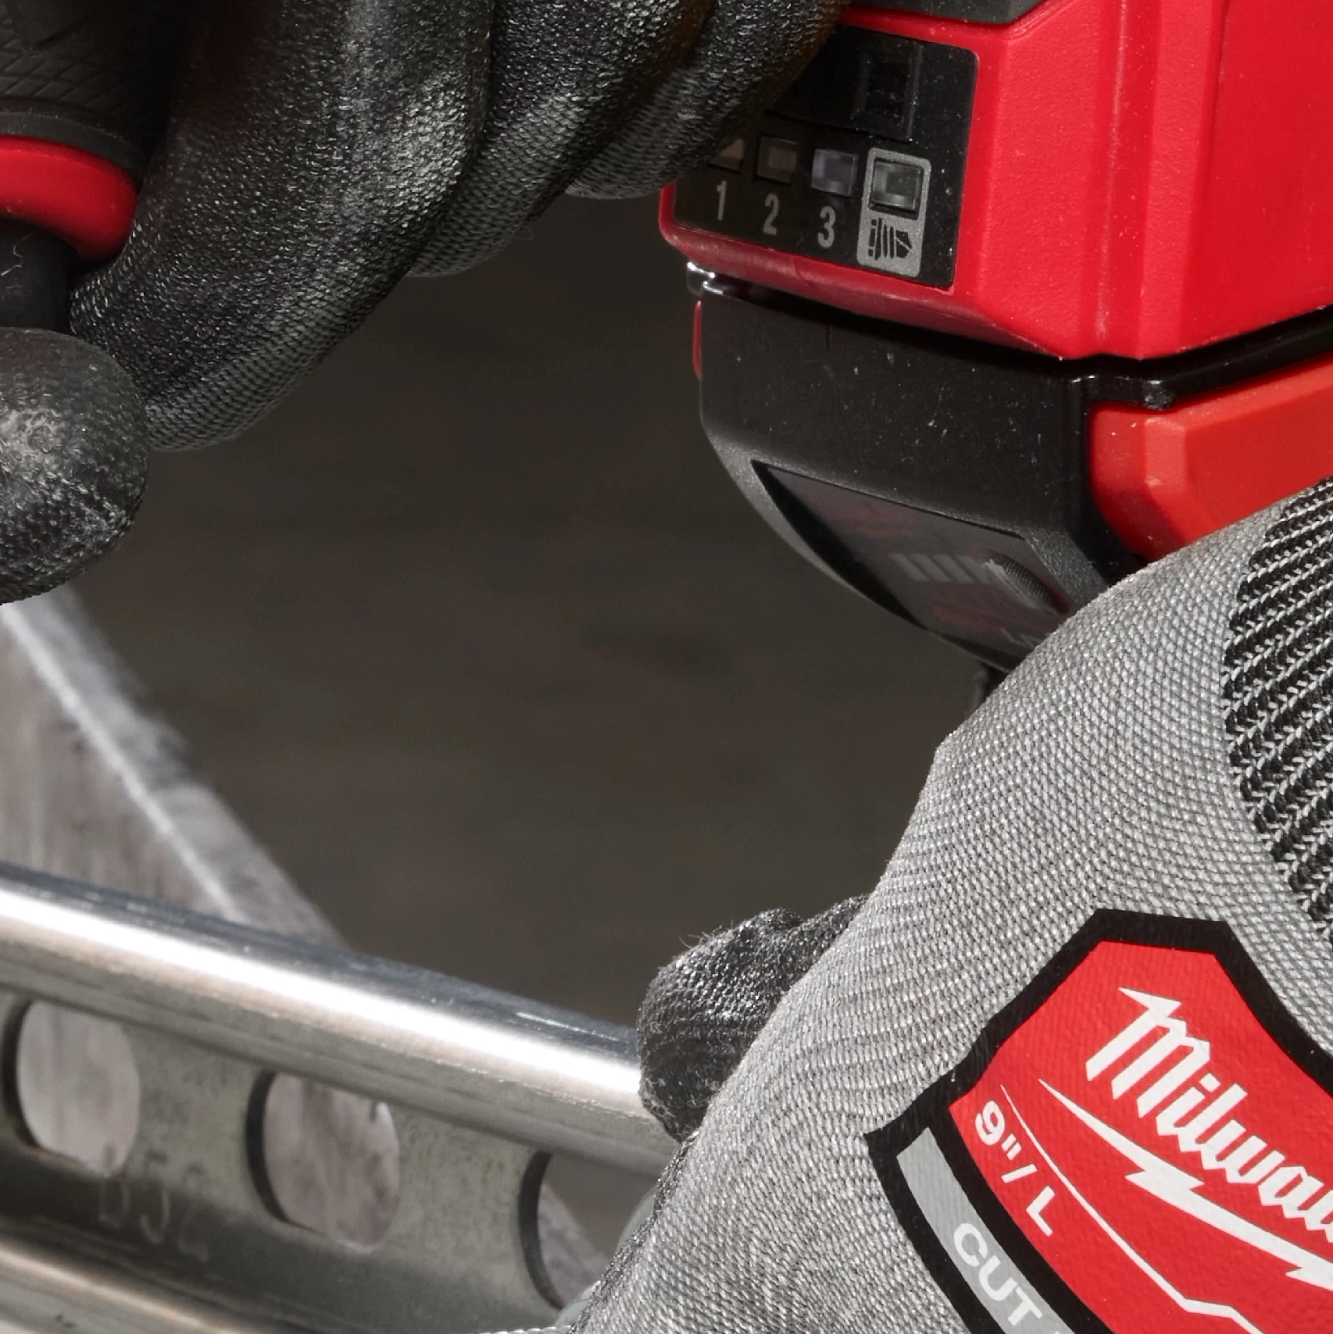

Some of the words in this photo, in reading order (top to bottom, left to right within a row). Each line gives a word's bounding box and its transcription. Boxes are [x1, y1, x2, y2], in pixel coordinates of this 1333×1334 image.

[715, 180, 728, 221] 1
[762, 193, 781, 236] 2
[817, 205, 837, 249] 3
[953, 1223, 1043, 1327] CUT
